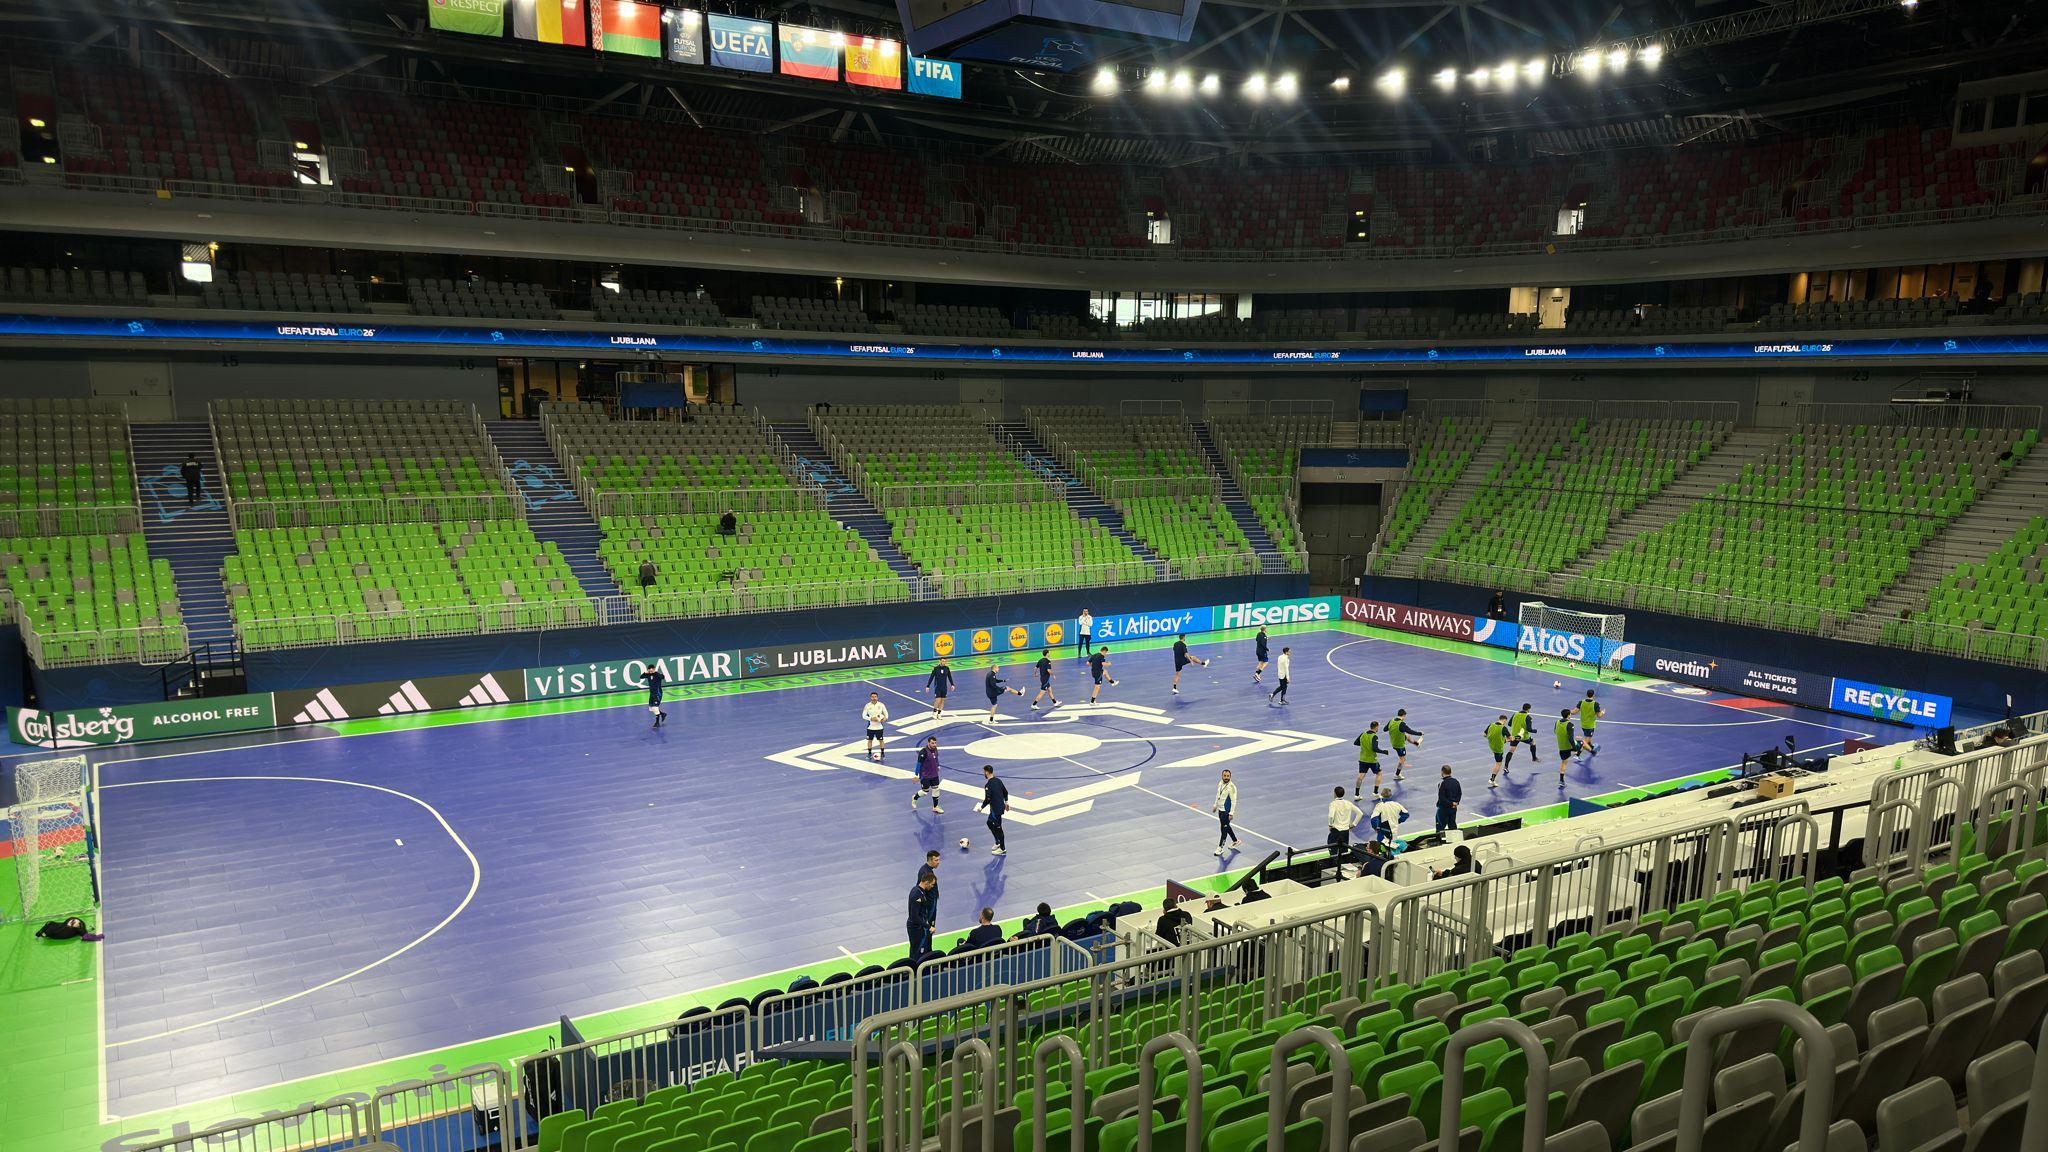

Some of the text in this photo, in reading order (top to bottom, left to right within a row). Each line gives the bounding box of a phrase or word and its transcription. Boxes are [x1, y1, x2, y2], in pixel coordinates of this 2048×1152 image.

[711, 30, 770, 56] UEFA
[914, 60, 954, 82] FIFA
[278, 326, 303, 335] UEFA
[302, 327, 339, 336] FUTSAL
[611, 336, 657, 345] LJUBLJANA
[1072, 351, 1104, 359] LJUBLJANA
[1754, 345, 1773, 353] UEFA
[222, 354, 239, 367] 15
[768, 367, 780, 377] 17
[1223, 601, 1331, 629] Hisense
[1345, 599, 1472, 637] QATAR AIRWAYS
[777, 644, 888, 668] LJUBLJANA
[1655, 657, 1709, 678] eventim
[1748, 670, 1797, 685] ALL TICKETS
[1743, 679, 1798, 695] IN ONE PLACE
[1844, 687, 1937, 718] RECYCLE
[17, 708, 134, 743] Carlsberg
[153, 706, 259, 726] ALCOHOL FREE
